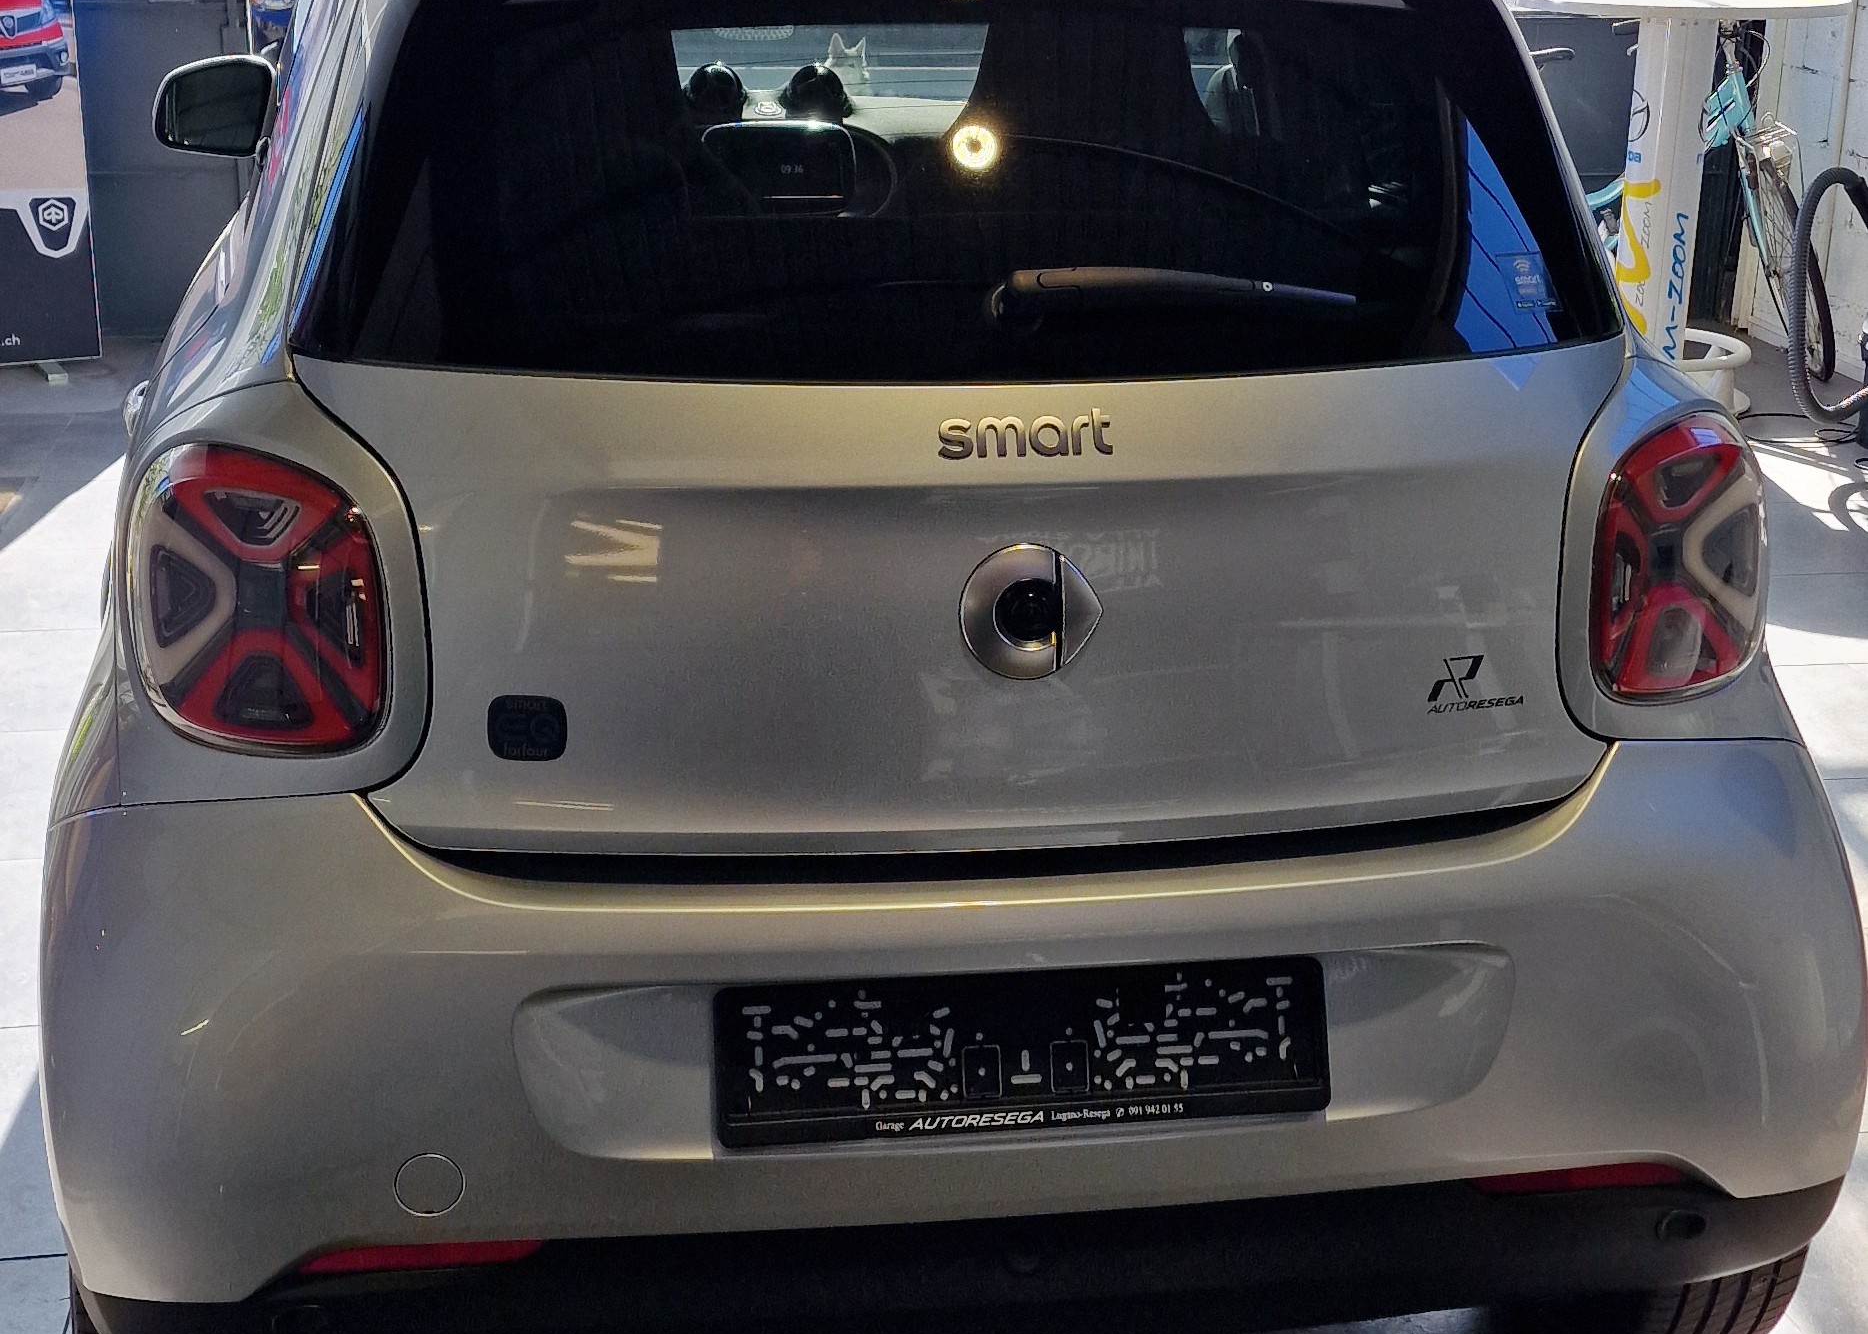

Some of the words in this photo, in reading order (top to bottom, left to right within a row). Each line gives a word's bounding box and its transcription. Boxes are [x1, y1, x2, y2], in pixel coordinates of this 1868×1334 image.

[1641, 201, 1653, 249] ZOOM
[938, 407, 1114, 460] smart
[1427, 695, 1524, 714] AUTORESEGA
[908, 1111, 1044, 1131] AUTORESEGA
